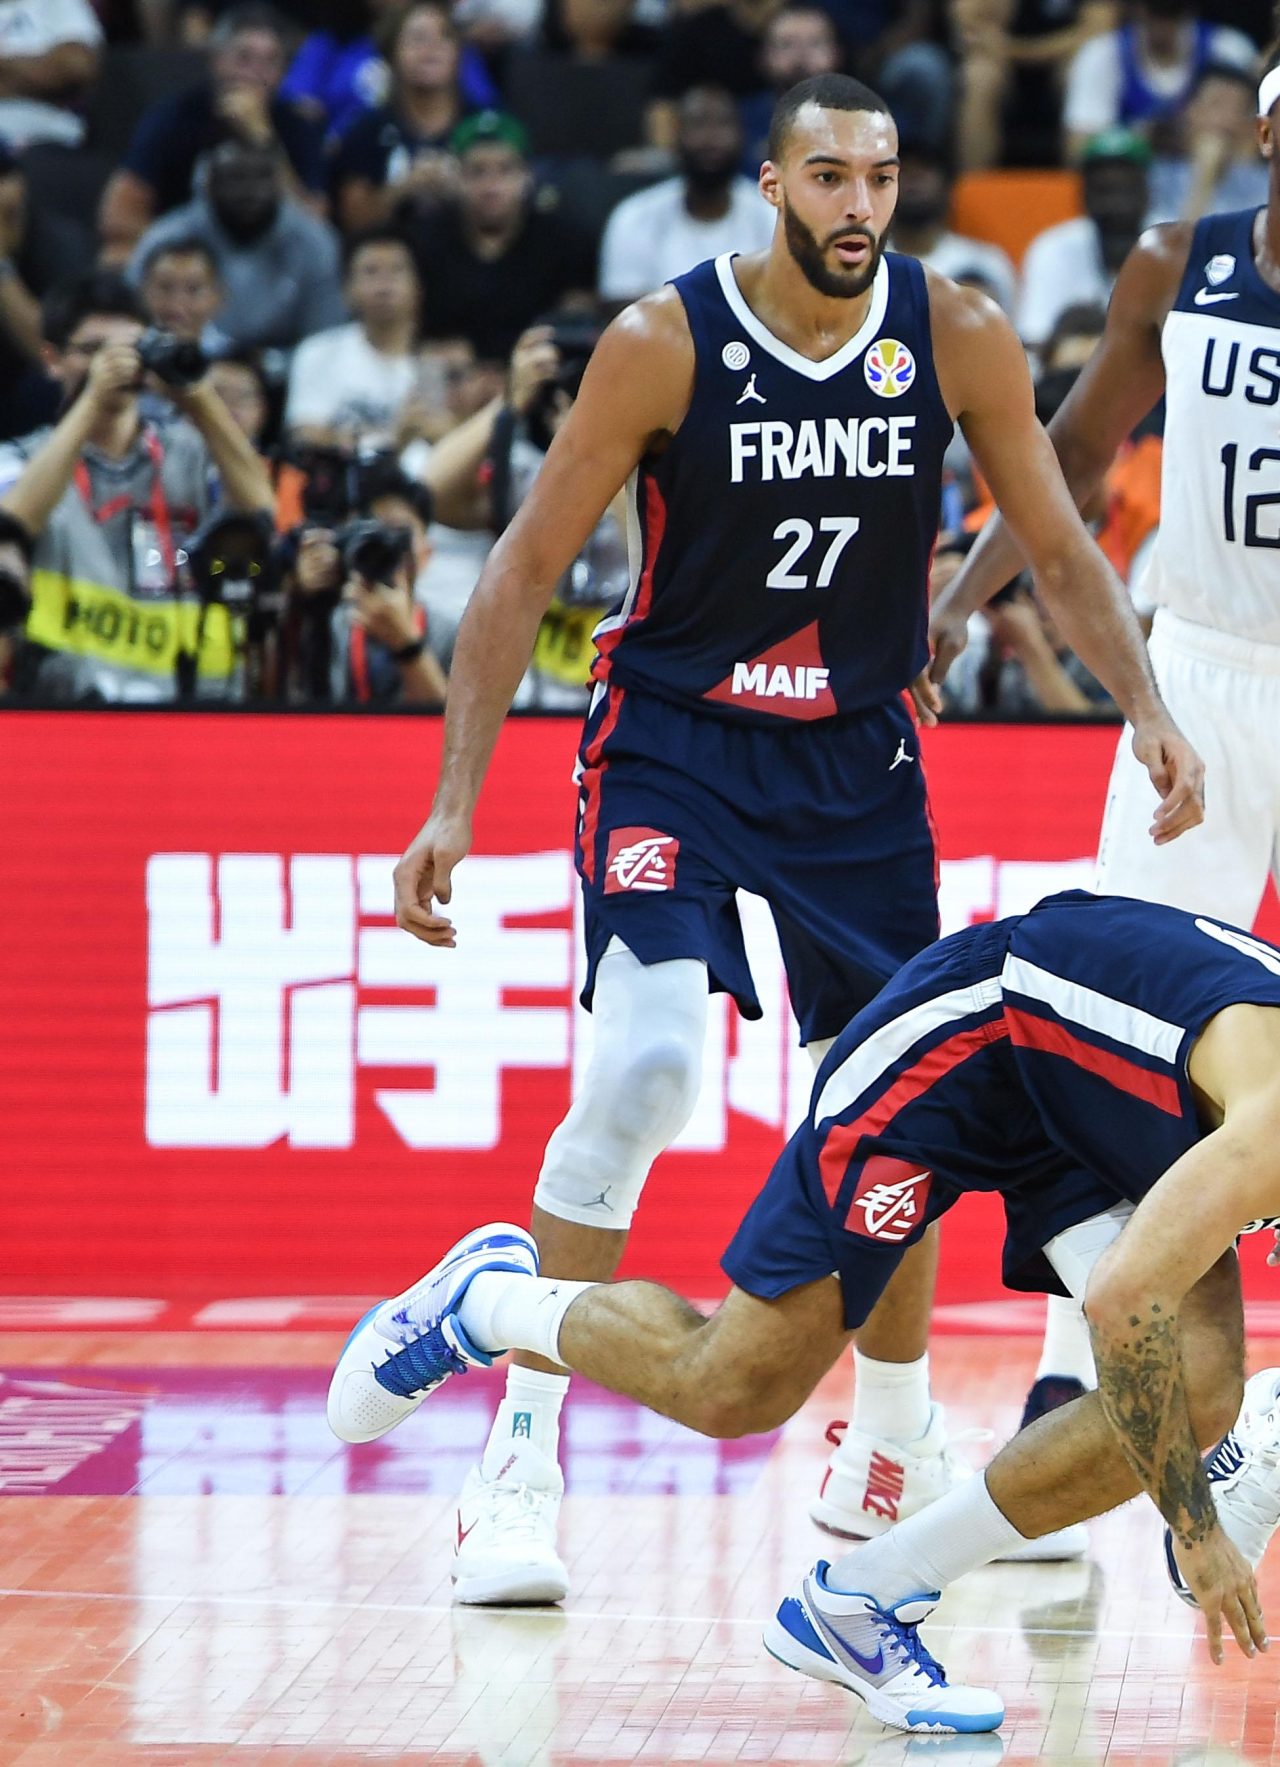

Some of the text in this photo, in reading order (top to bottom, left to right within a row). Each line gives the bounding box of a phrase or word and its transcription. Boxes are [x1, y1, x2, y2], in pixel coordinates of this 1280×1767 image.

[730, 415, 916, 483] FRANCE
[766, 516, 860, 590] 27
[731, 662, 830, 699] MAIF
[862, 1449, 904, 1522] NIKE
